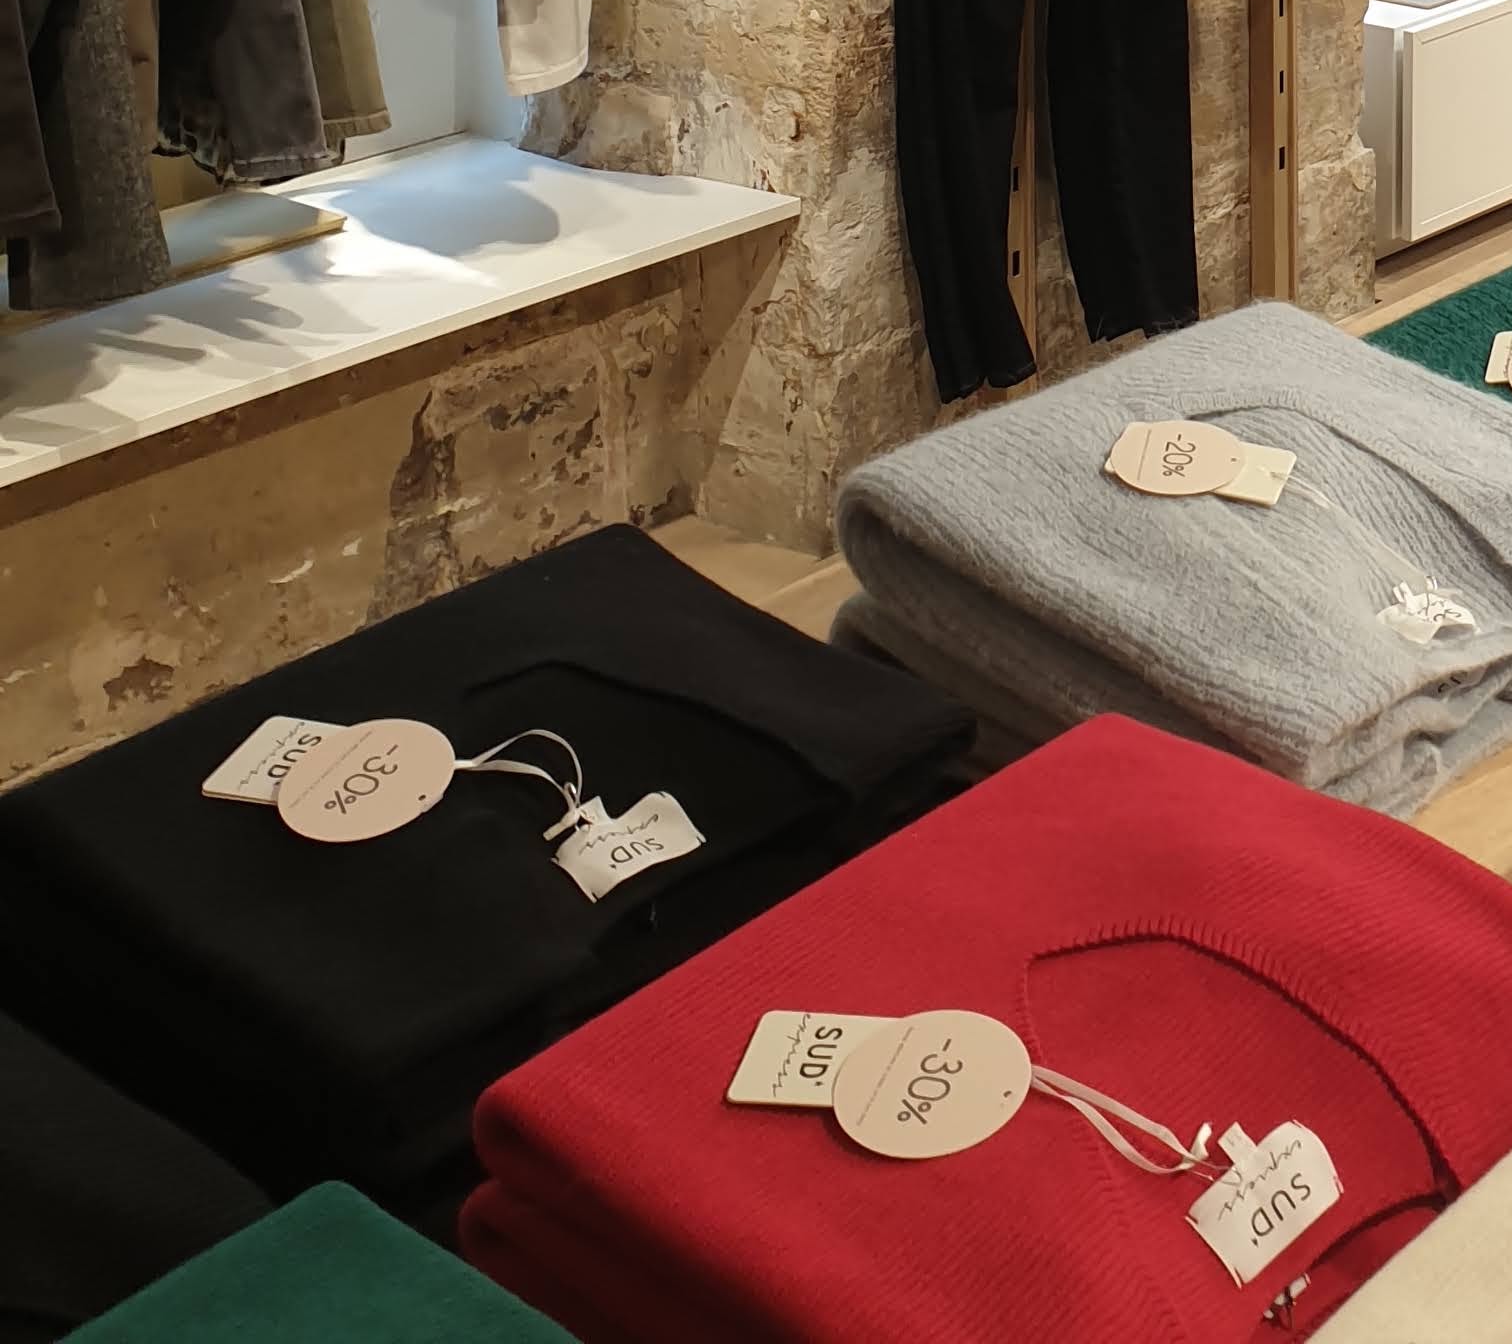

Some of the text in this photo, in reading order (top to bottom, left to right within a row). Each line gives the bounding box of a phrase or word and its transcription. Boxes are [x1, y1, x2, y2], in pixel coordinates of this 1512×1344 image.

[1161, 433, 1197, 478] -20%
[323, 744, 399, 814] -30%
[772, 1013, 811, 1097] express
[897, 1038, 963, 1125] -30%
[1217, 1139, 1302, 1222] express
